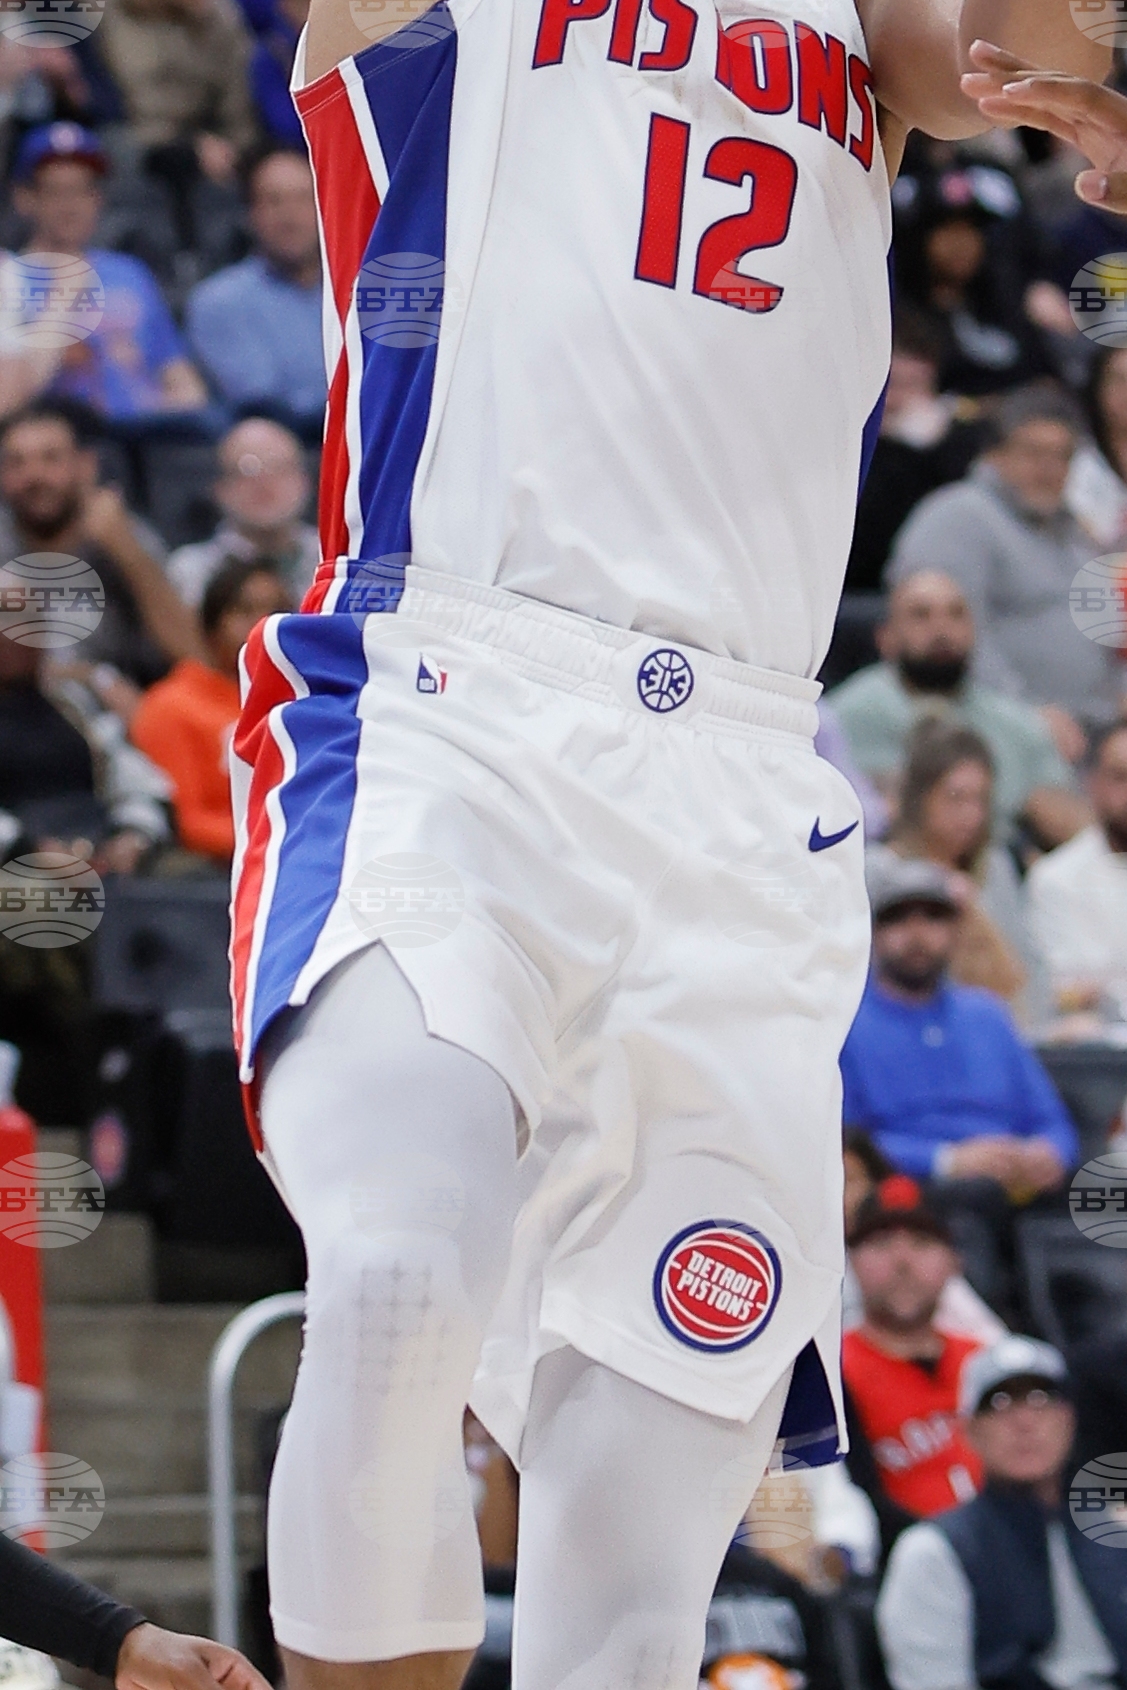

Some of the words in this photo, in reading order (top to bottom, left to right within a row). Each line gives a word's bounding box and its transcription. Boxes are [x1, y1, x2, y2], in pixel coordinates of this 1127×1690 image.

[634, 111, 798, 315] 12
[676, 1269, 754, 1322] PISTONS
[687, 1250, 763, 1300] DETROIT
